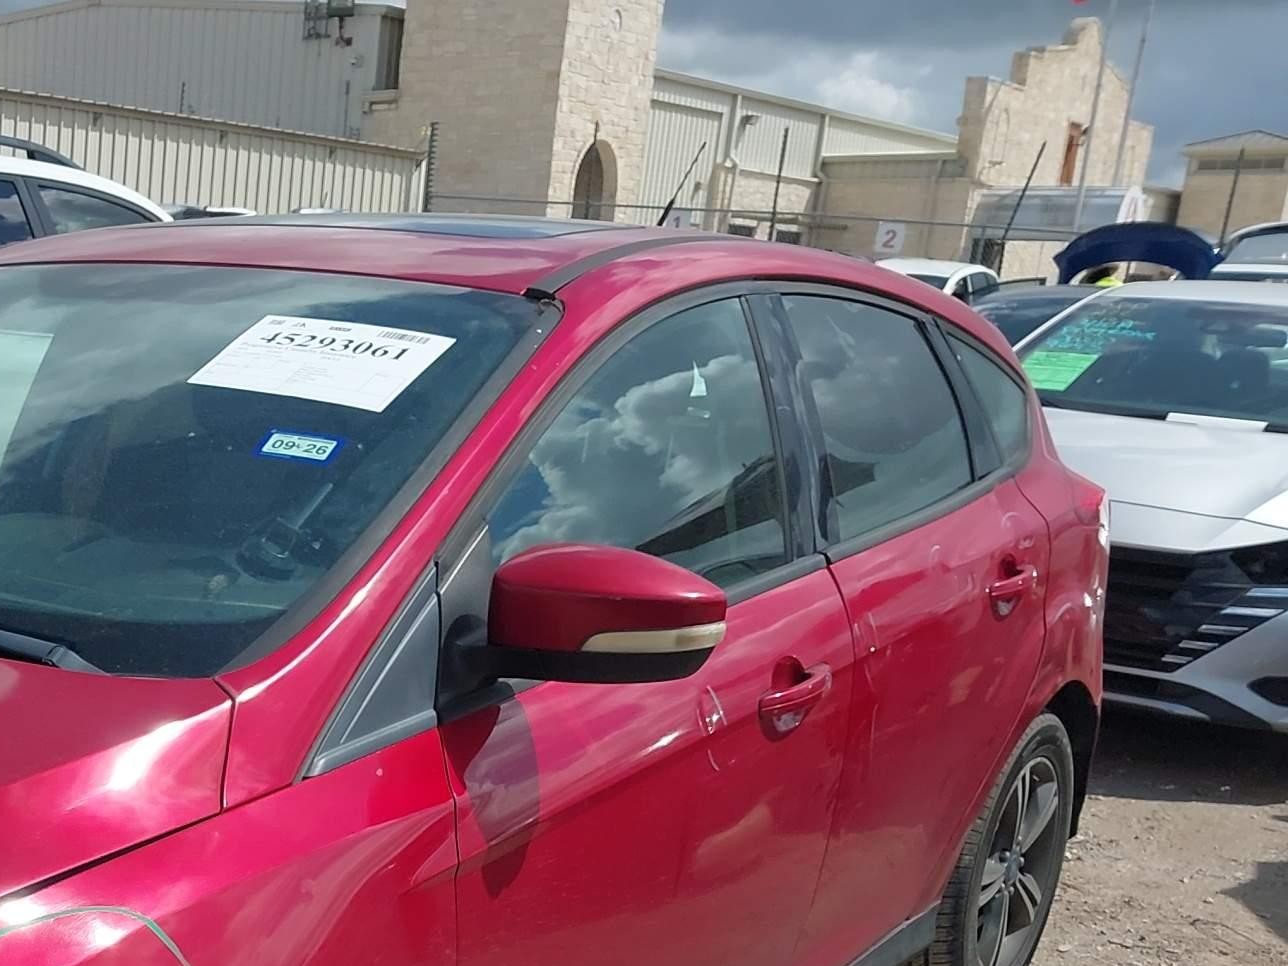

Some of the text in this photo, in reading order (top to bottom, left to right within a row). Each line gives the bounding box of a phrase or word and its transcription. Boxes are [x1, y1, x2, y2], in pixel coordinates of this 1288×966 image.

[673, 216, 681, 228] 1
[881, 229, 897, 248] 2
[260, 331, 410, 360] 45293061
[271, 439, 329, 455] 09 26
